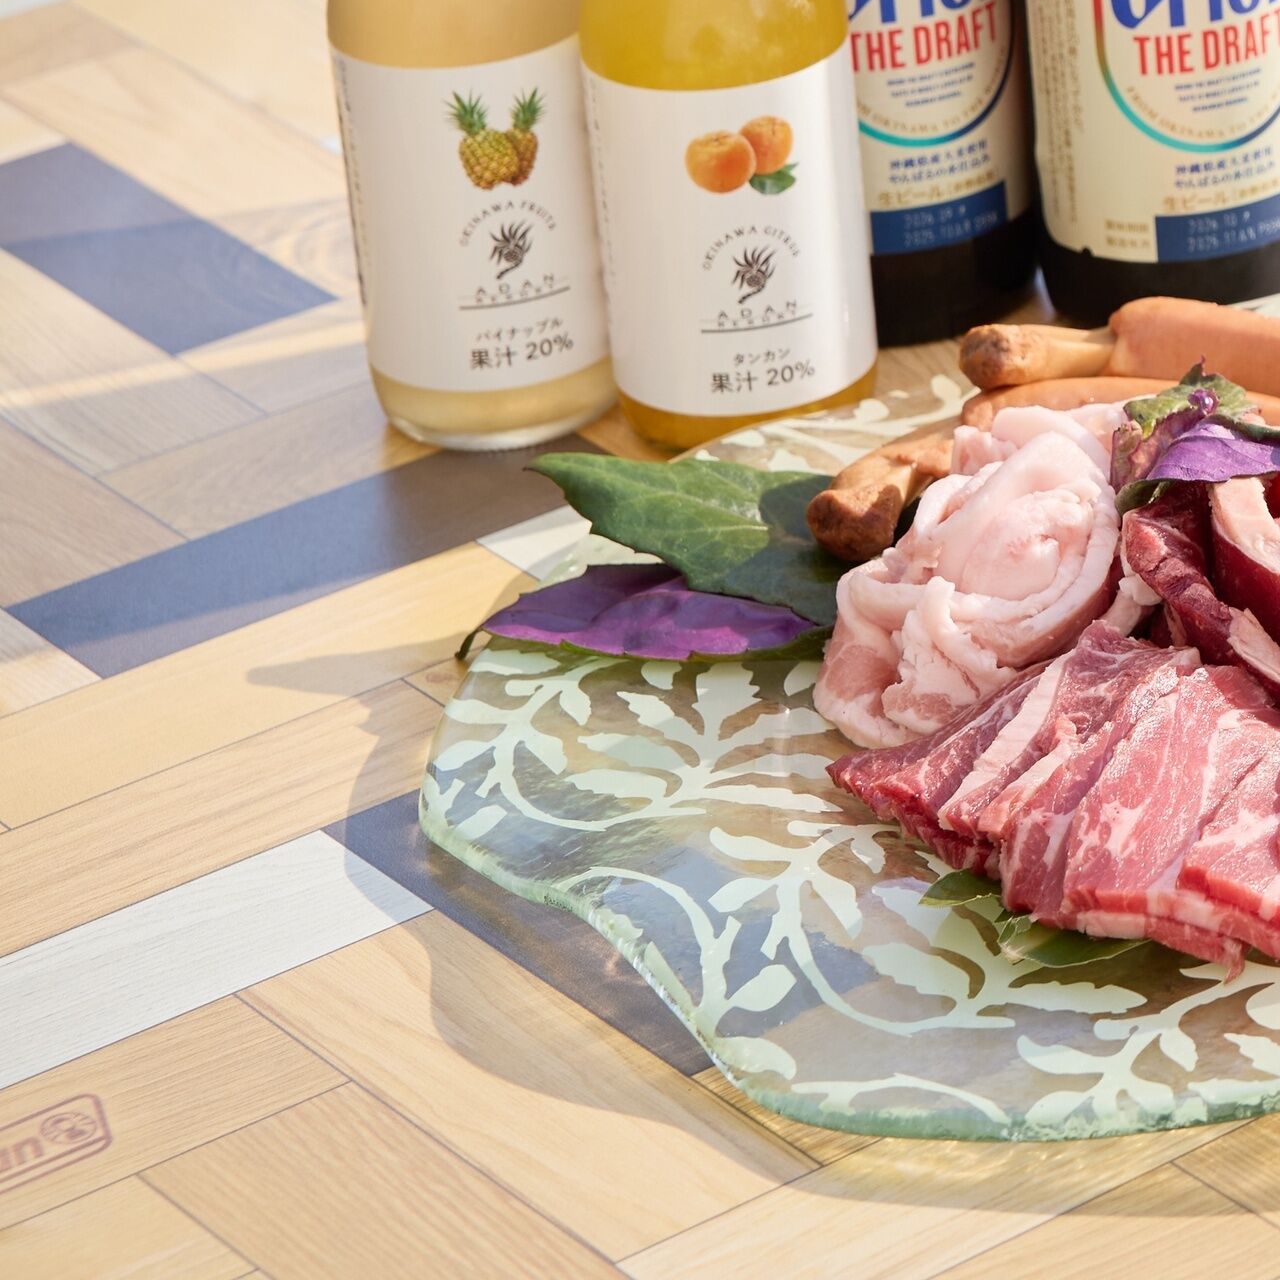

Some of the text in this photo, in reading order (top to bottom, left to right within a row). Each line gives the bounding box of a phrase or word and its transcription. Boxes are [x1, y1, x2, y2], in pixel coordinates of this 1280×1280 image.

[851, 0, 998, 72] THE DRAFT
[1133, 33, 1194, 76] THE
[459, 200, 514, 247] OKINAWA
[702, 225, 757, 271] OKINAWA
[471, 331, 574, 370] 果汁 20%
[475, 317, 563, 343] パイナップル
[711, 359, 815, 393] 果汁 20%
[733, 348, 791, 367] タンカン
